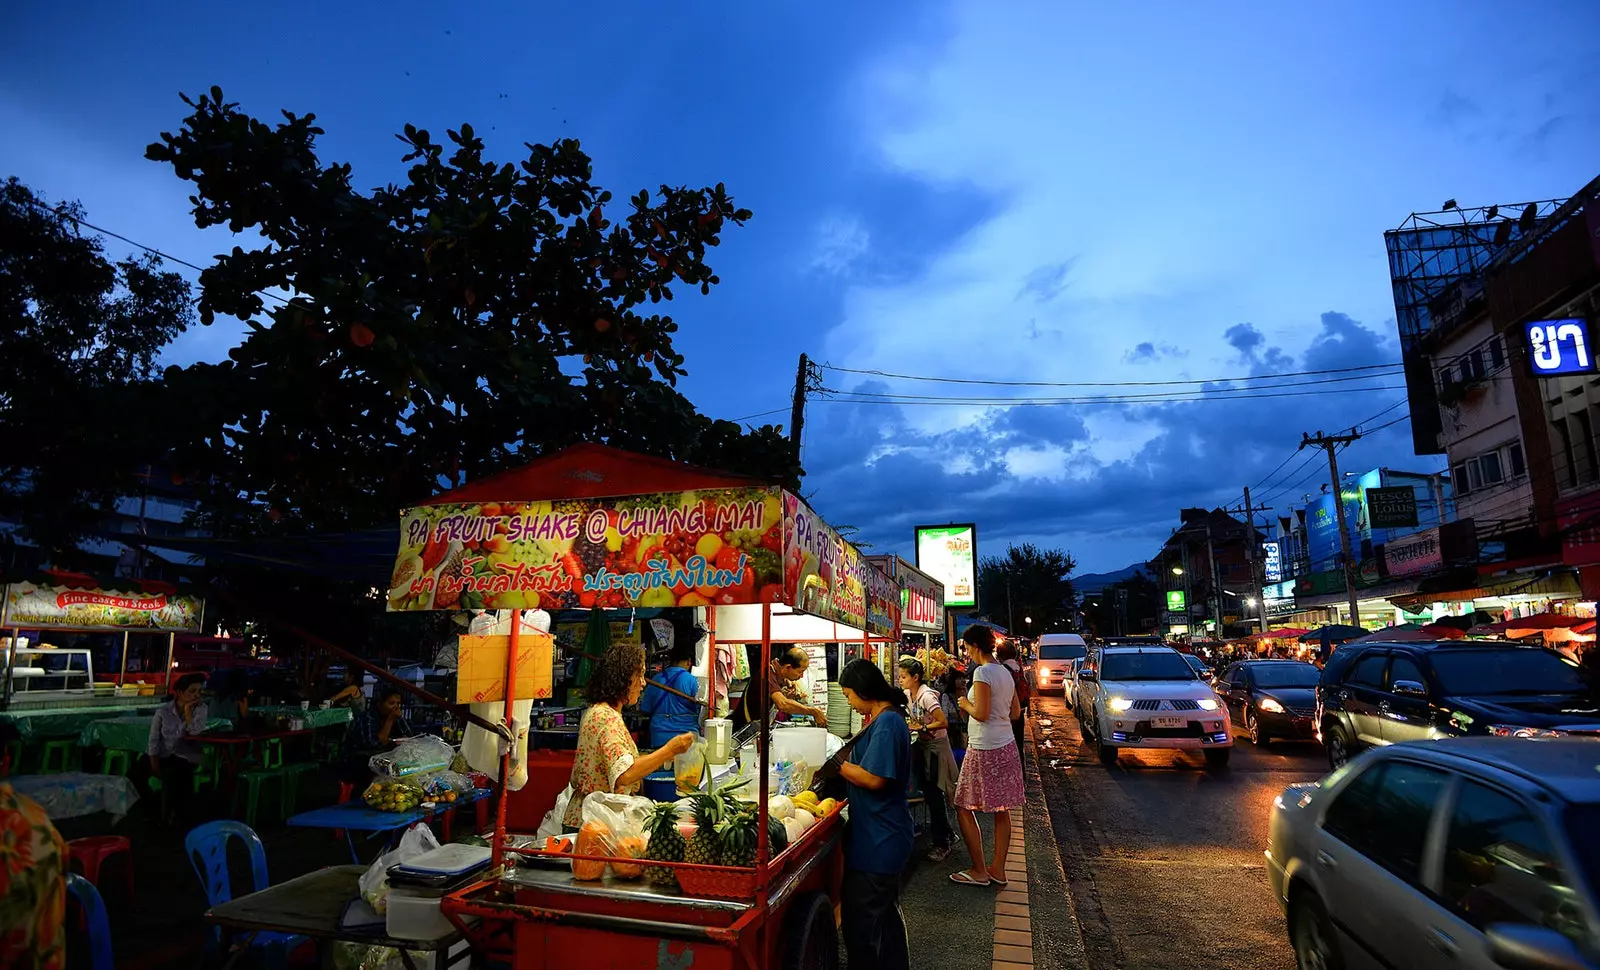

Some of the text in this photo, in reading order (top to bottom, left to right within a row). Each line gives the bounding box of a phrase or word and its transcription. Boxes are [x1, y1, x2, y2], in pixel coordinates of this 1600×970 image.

[1530, 324, 1589, 370] ยา
[1371, 491, 1413, 502] TESCO
[408, 500, 765, 546] PA FRUIT SHAKE @ CHIANG MAI
[796, 513, 812, 550] PA
[584, 552, 748, 602] ประตูเชียงใหม่
[63, 592, 91, 604] Fine
[131, 599, 162, 610] Steak
